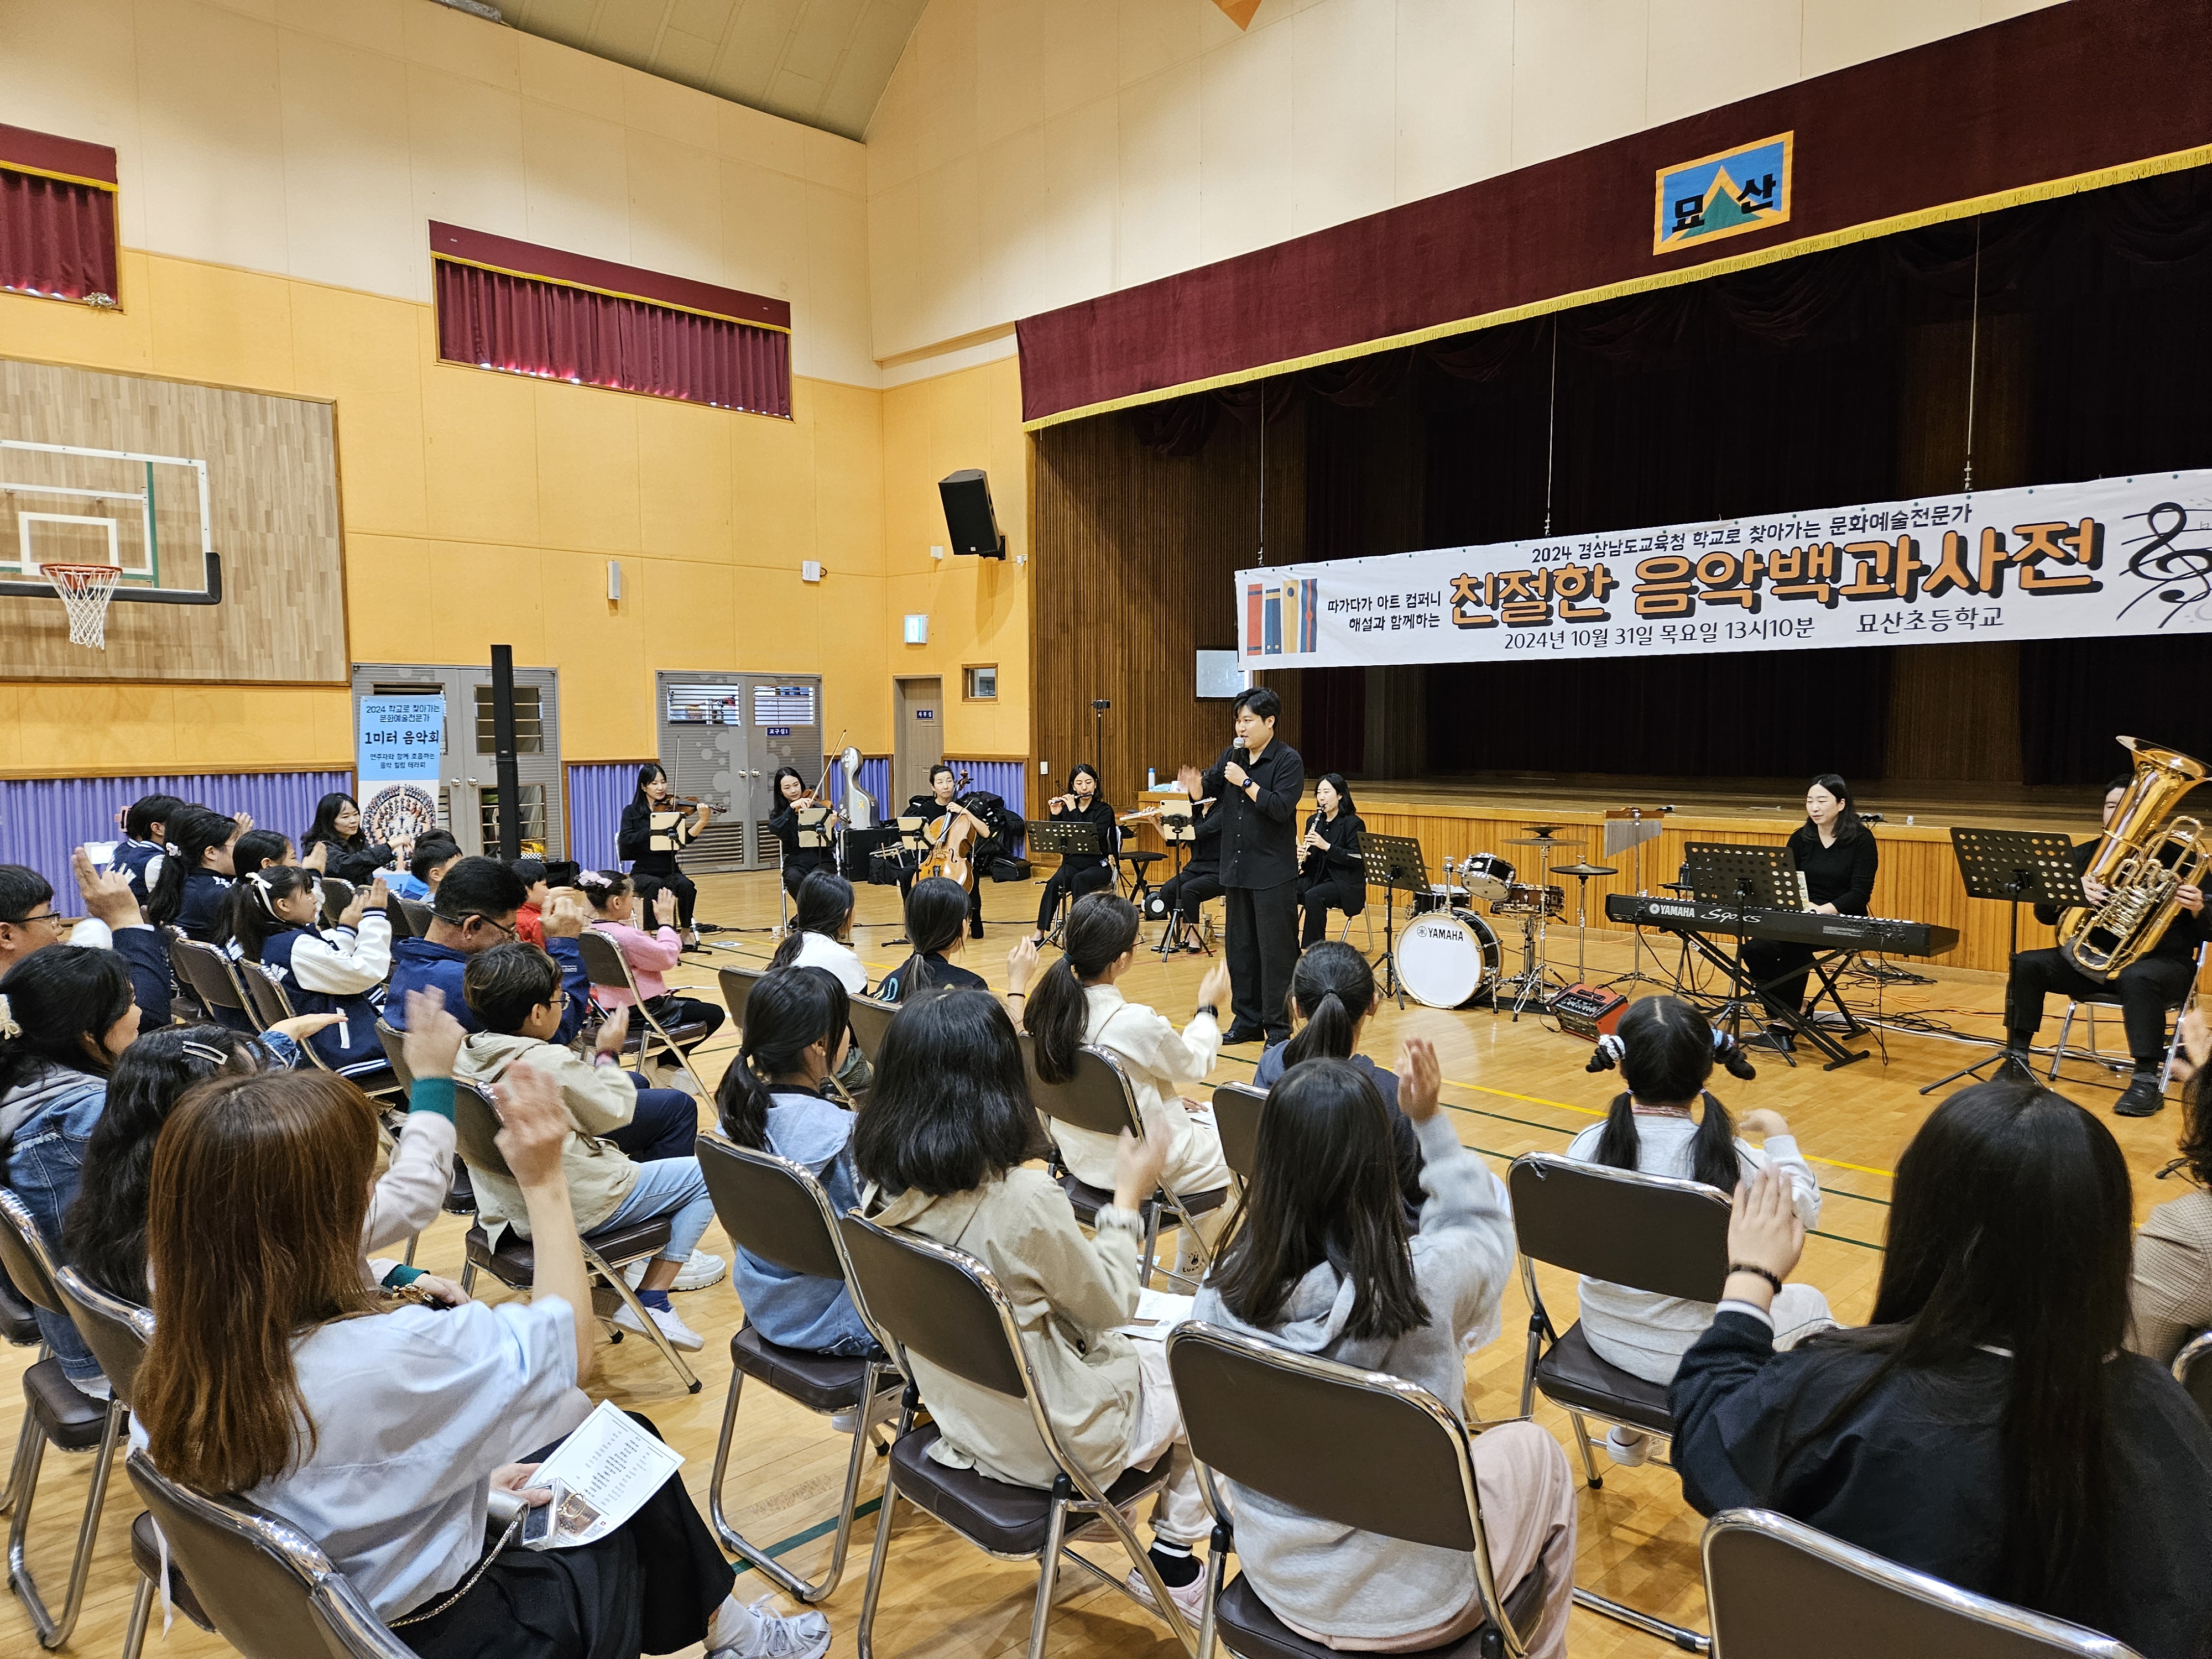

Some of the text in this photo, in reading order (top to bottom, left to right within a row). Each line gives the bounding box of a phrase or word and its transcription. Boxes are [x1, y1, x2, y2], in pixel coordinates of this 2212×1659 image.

[1531, 503, 1973, 564] 2024 경상남도교육청 학교로 찾아가는 문화예술전문가
[1448, 515, 2105, 629] 친절한 음악백과사전
[1327, 591, 1441, 614] 따가다가 아트 컴퍼니
[1349, 613, 1441, 632] 해설과 함께하는
[1856, 607, 2004, 634] 묘산초등학교
[1504, 617, 1815, 650] 2024년 10월 31일 목요일 13시10분
[379, 714, 430, 722] 문화예술전문가
[389, 705, 410, 713] 학교로
[412, 705, 440, 713] 찾아가는
[365, 730, 439, 744] 1미터 음악회
[1660, 904, 1695, 918] YAMAHA
[1428, 927, 1464, 942] YAMAHA
